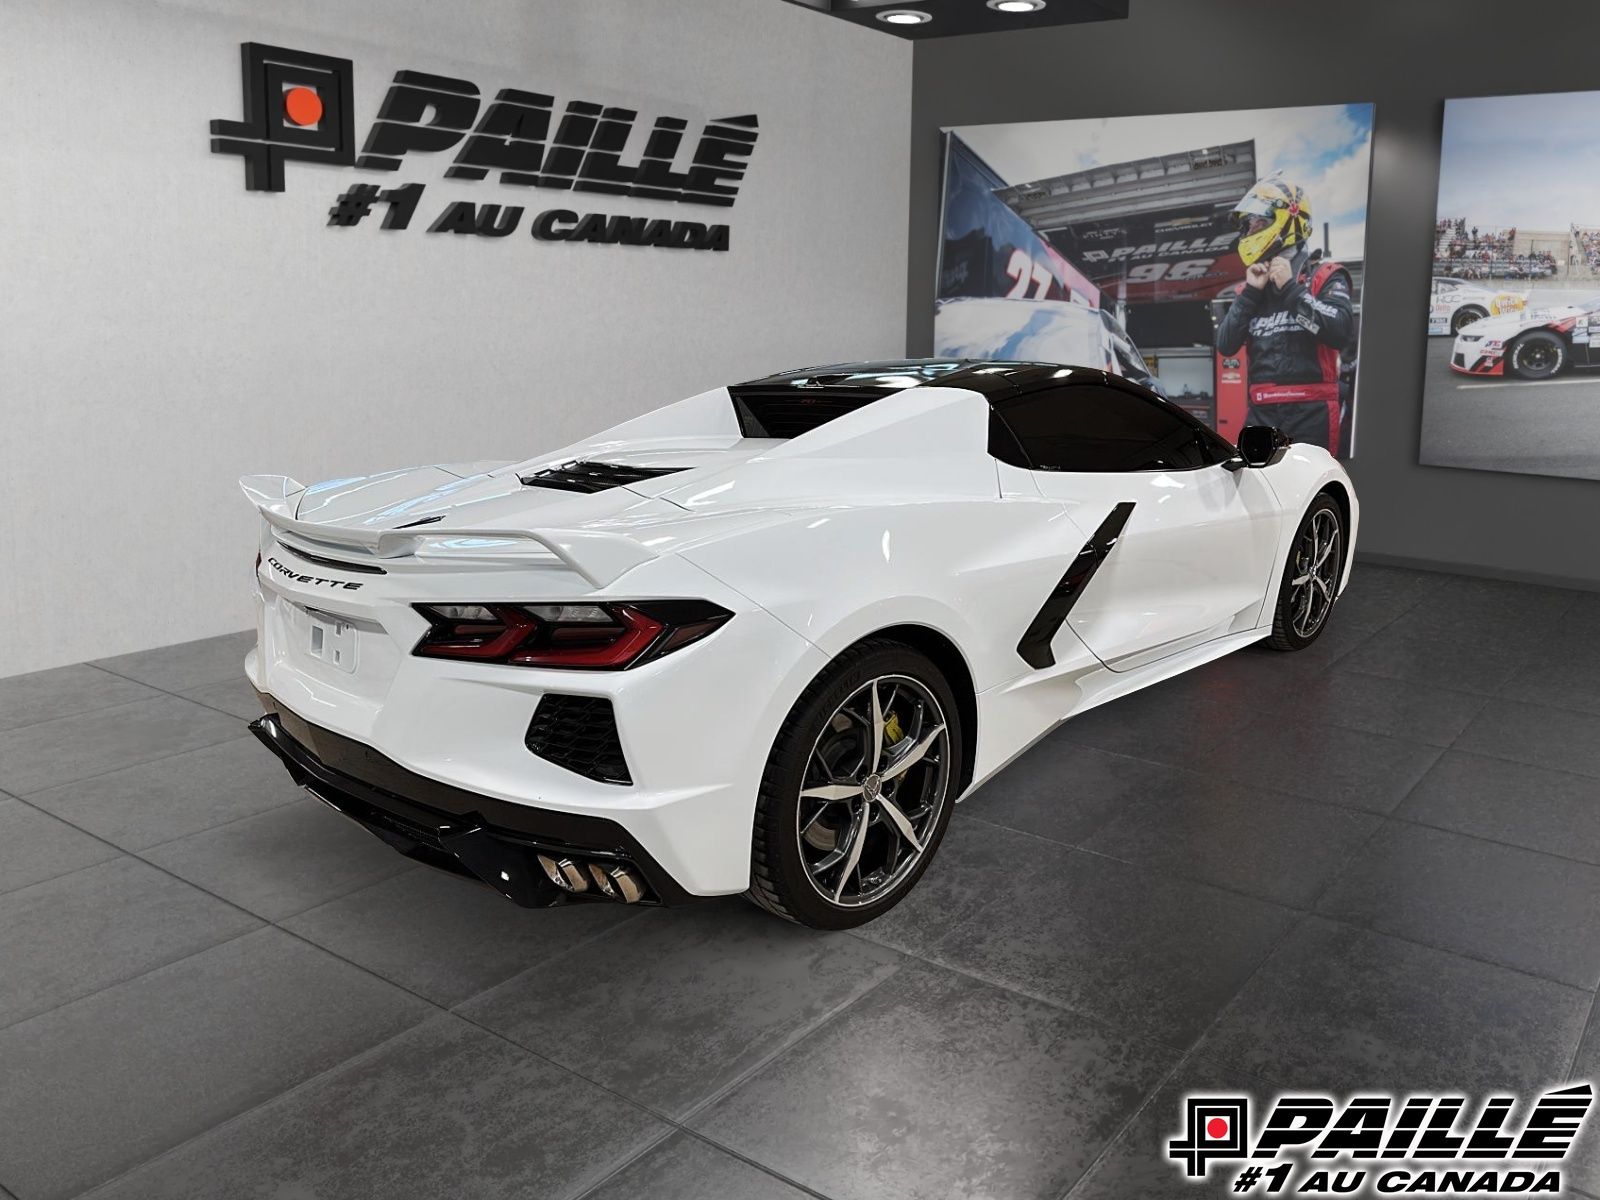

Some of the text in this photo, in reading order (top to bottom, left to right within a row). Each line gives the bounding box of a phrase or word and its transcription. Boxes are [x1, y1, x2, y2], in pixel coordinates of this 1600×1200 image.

[354, 69, 759, 208] PAILLÉ
[326, 182, 730, 252] #1 AU CANADA
[1125, 258, 1216, 284] 96
[267, 557, 364, 591] CORVETTE
